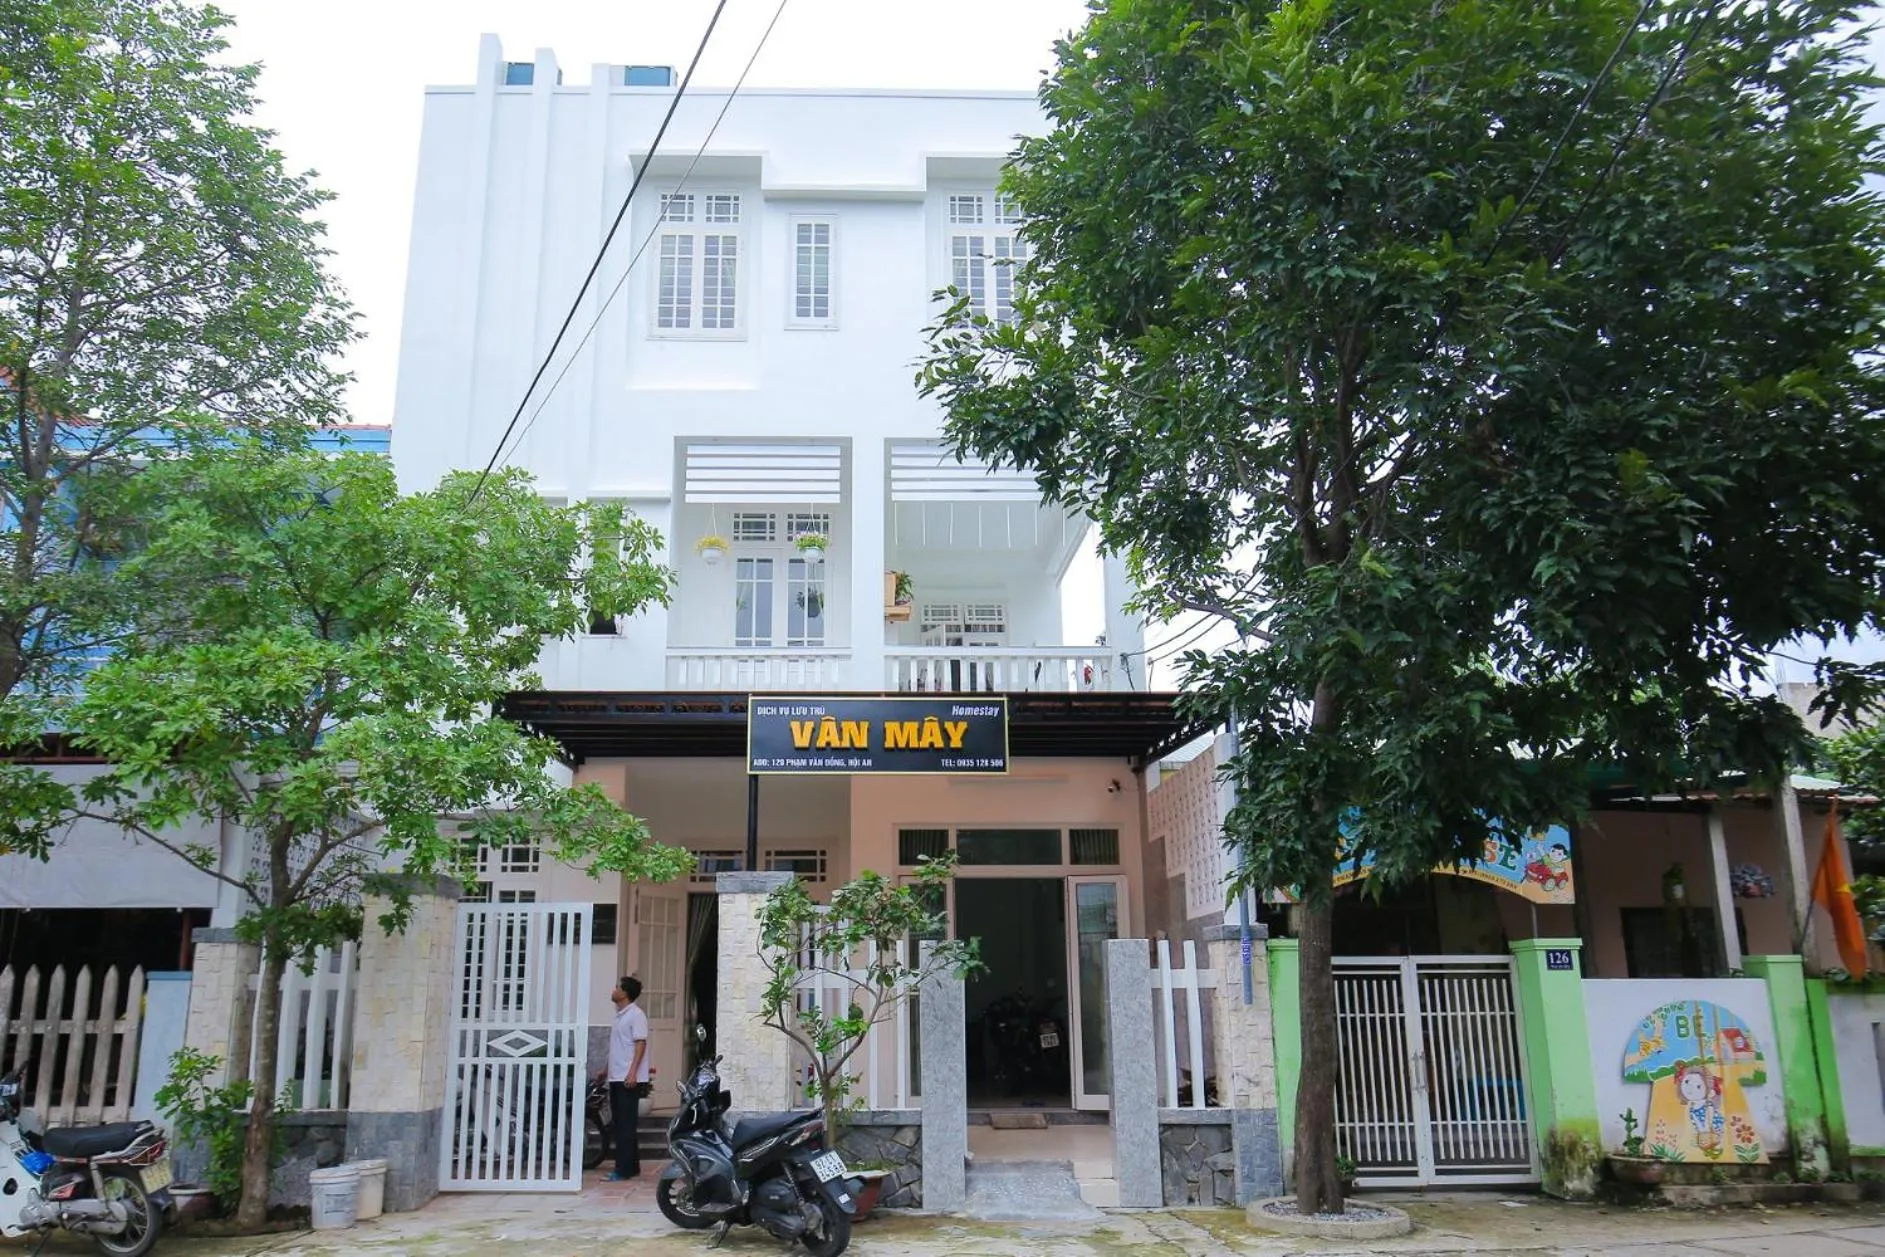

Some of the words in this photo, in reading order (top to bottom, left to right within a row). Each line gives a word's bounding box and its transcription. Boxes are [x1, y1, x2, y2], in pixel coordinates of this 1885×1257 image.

[952, 705, 999, 717] Homestay
[790, 715, 870, 749] VÂN
[883, 715, 968, 749] MÂY
[862, 758, 872, 766] AN
[940, 758, 955, 767] TEL:
[1548, 952, 1569, 964] 126
